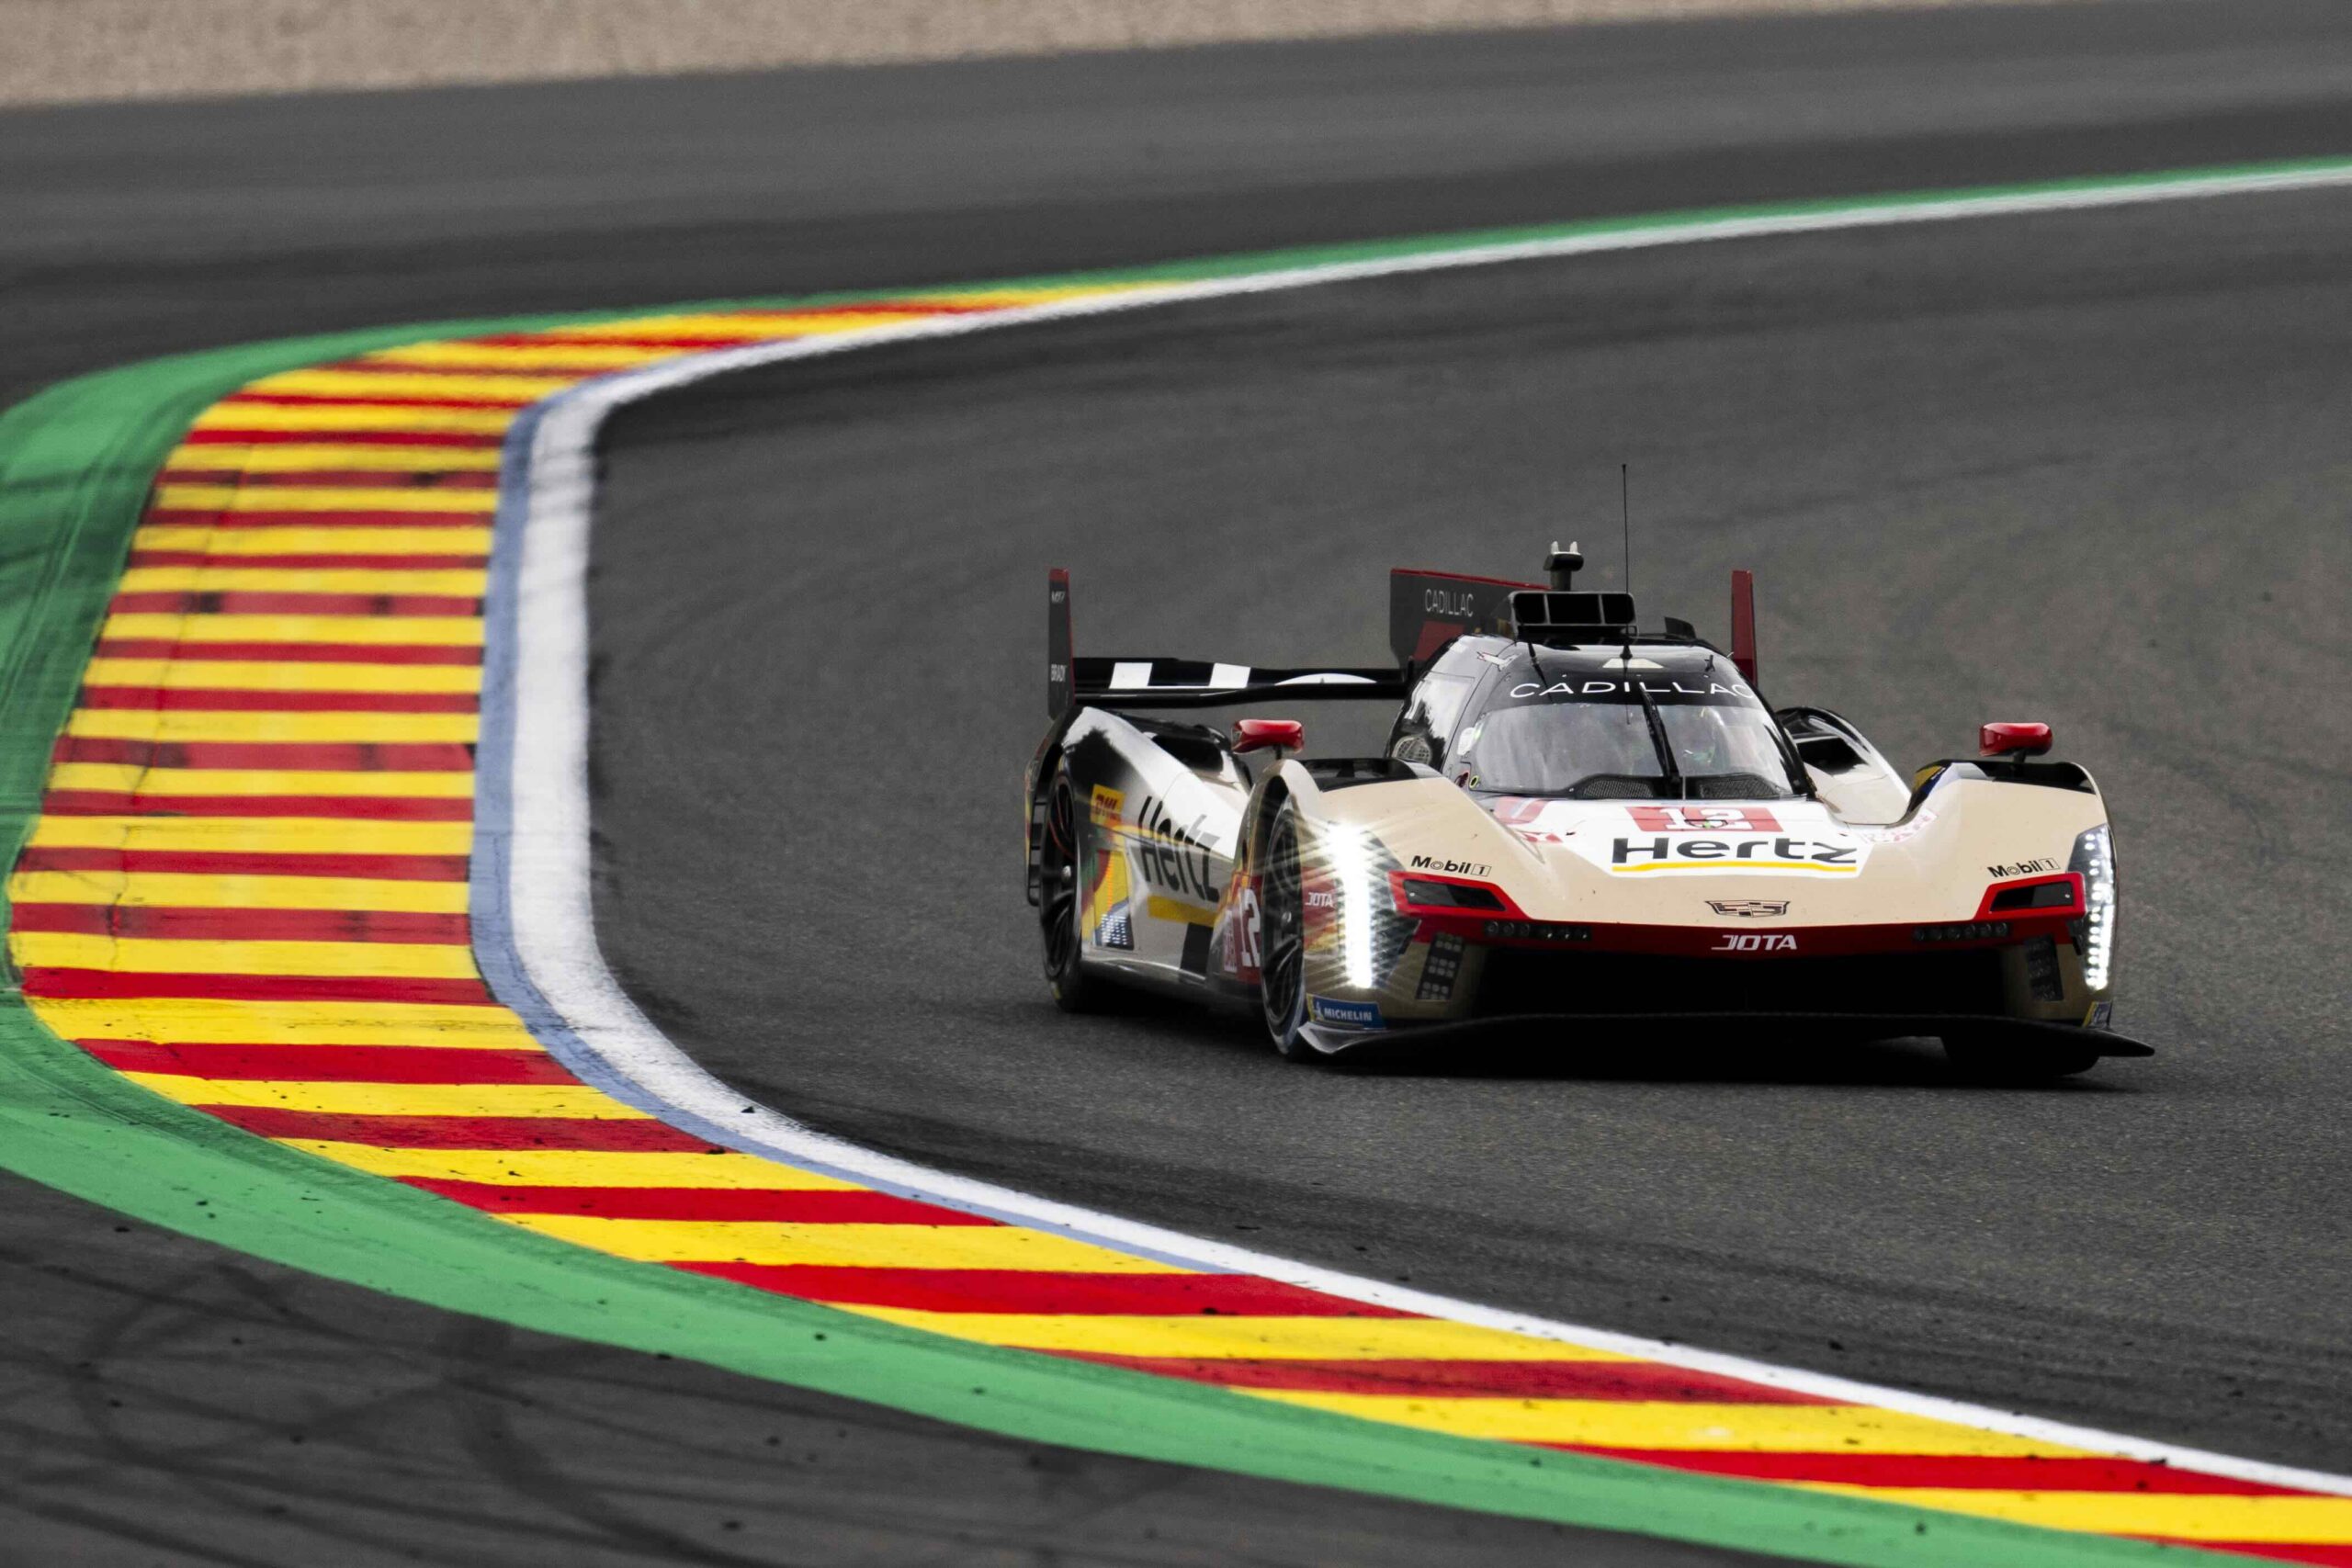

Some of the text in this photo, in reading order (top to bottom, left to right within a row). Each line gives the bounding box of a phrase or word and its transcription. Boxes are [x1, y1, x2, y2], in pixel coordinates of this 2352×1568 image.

[1425, 589, 1474, 617] CADILLAC
[1510, 681, 1755, 699] CADILLAC
[1660, 807, 1754, 830] 12
[1612, 837, 1858, 864] Hertz
[1410, 855, 1471, 874] Mobil
[1987, 860, 2043, 877] Mobil
[1306, 892, 1334, 908] JOTA
[1712, 934, 1798, 952] JOTA
[1324, 1008, 1373, 1021] MICHELIN
